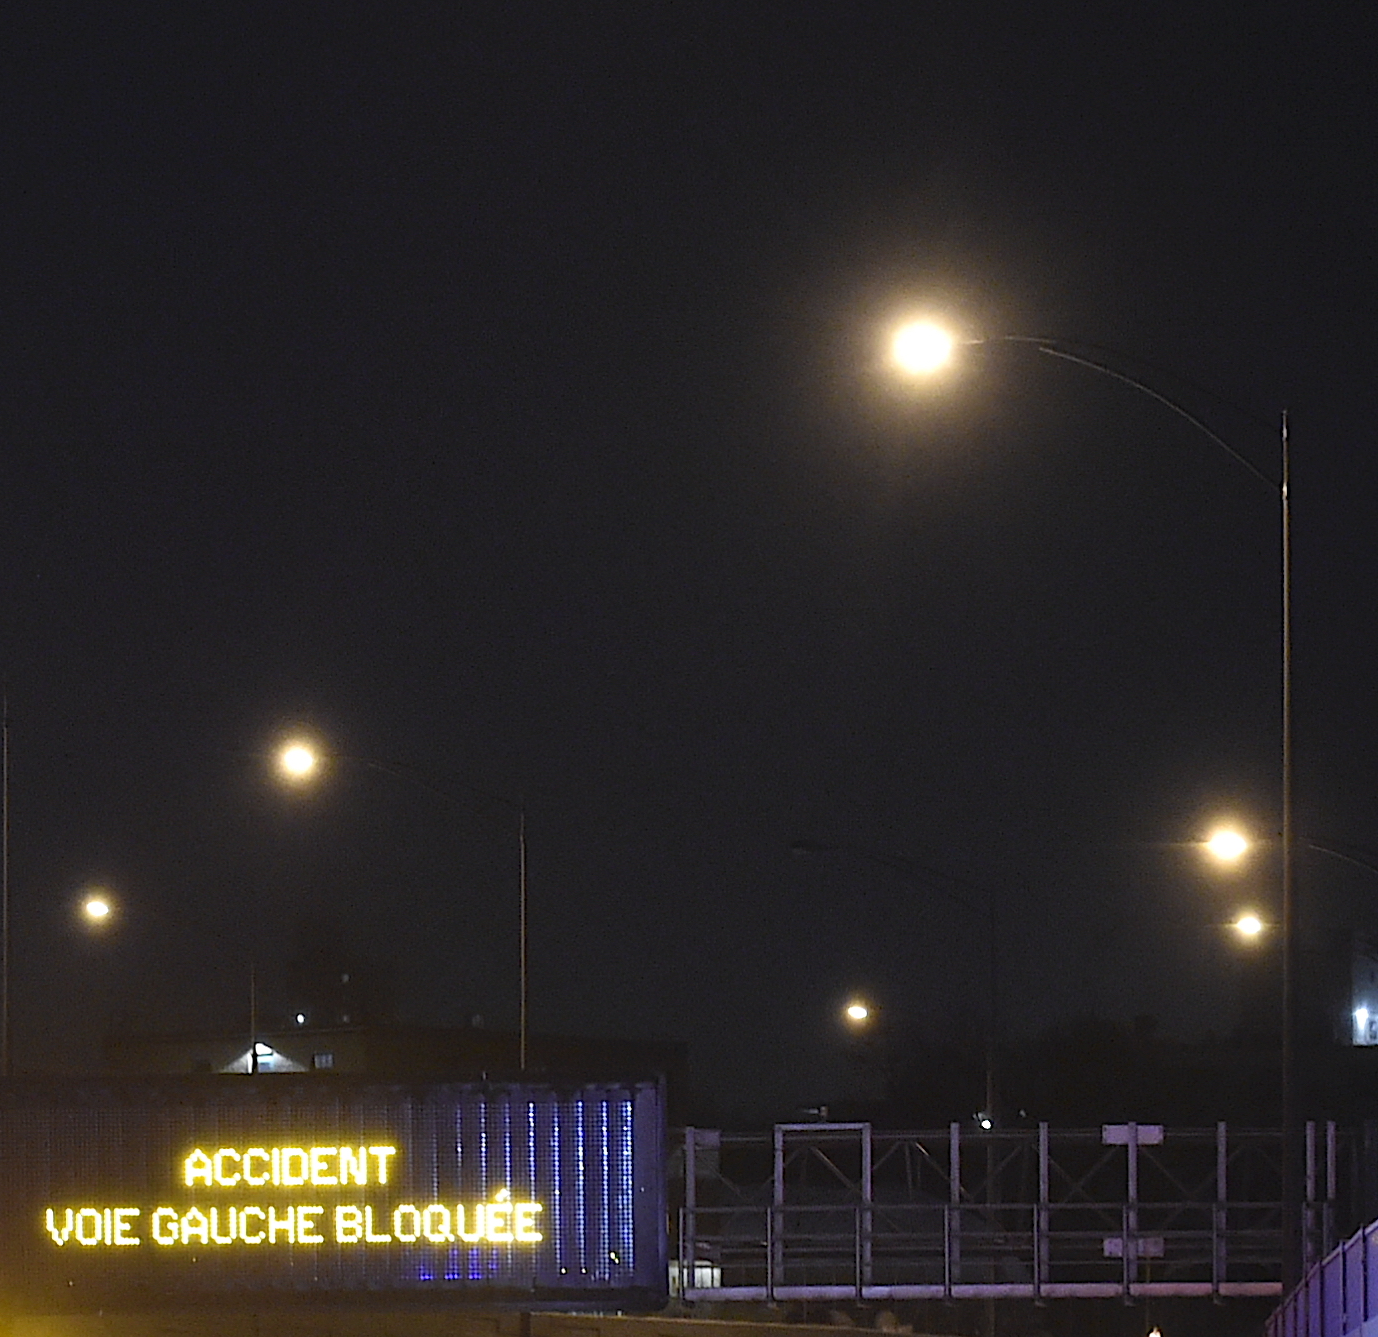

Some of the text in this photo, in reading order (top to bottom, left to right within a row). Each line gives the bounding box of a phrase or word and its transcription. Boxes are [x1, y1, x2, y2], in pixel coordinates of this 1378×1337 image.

[184, 1146, 396, 1187] ACCIDENT
[45, 1189, 543, 1247] VOIE GAUCHE BLOQUÉE
